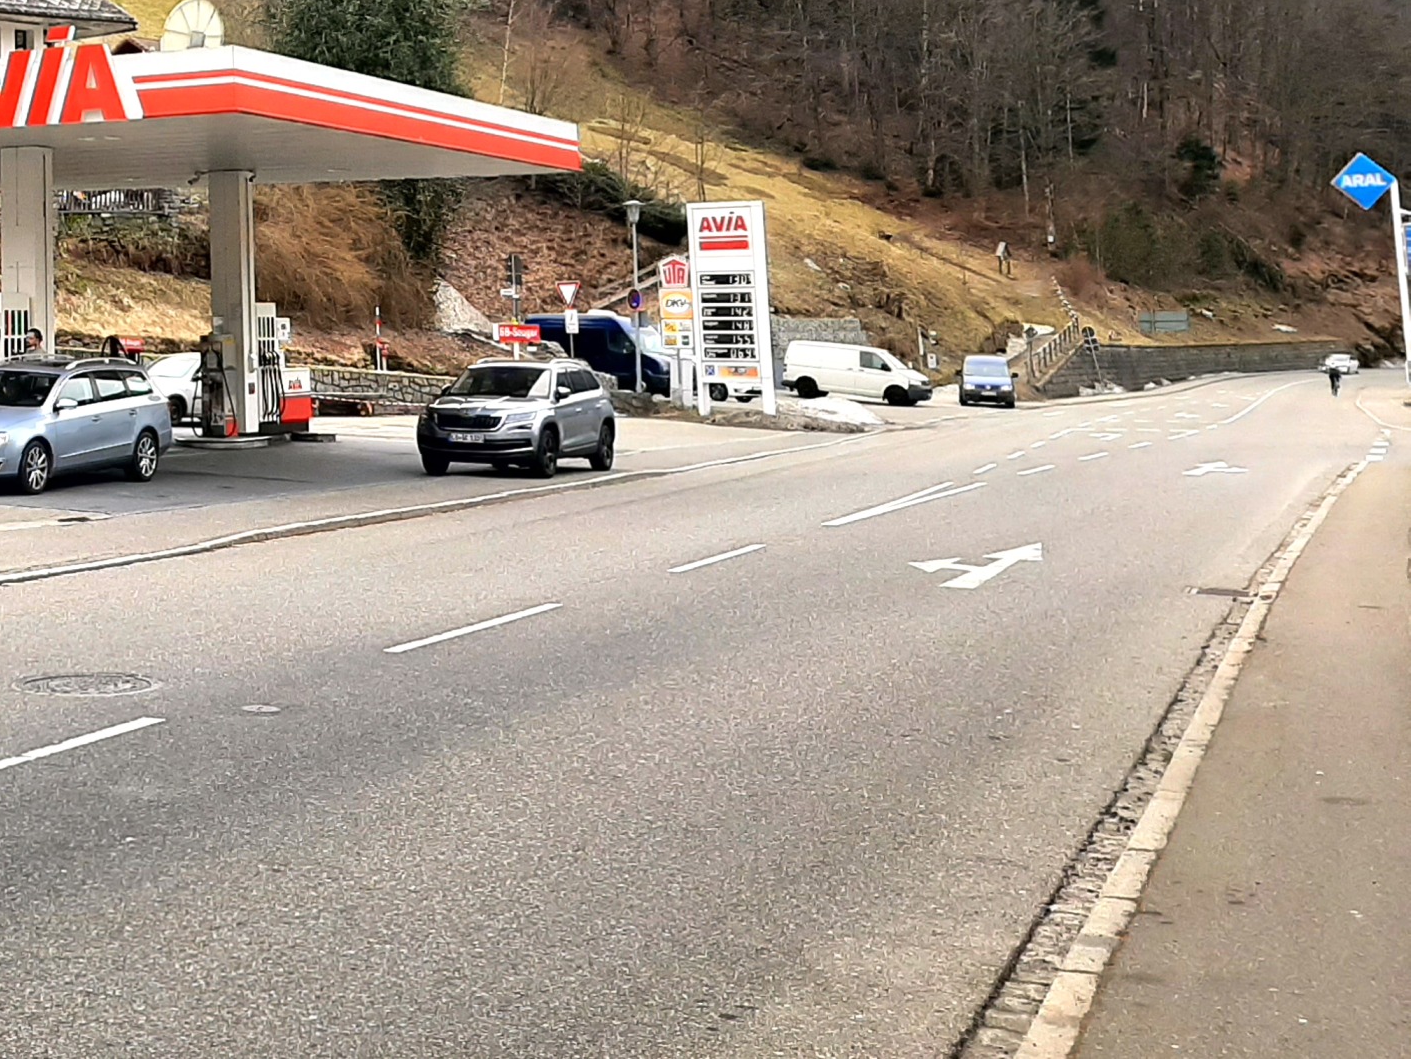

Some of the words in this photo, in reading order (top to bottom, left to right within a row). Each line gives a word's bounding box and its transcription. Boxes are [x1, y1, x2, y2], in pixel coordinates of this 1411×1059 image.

[1340, 172, 1387, 189] ARAL
[699, 211, 748, 233] AVIA
[662, 258, 686, 285] UTA
[665, 298, 687, 308] DKV
